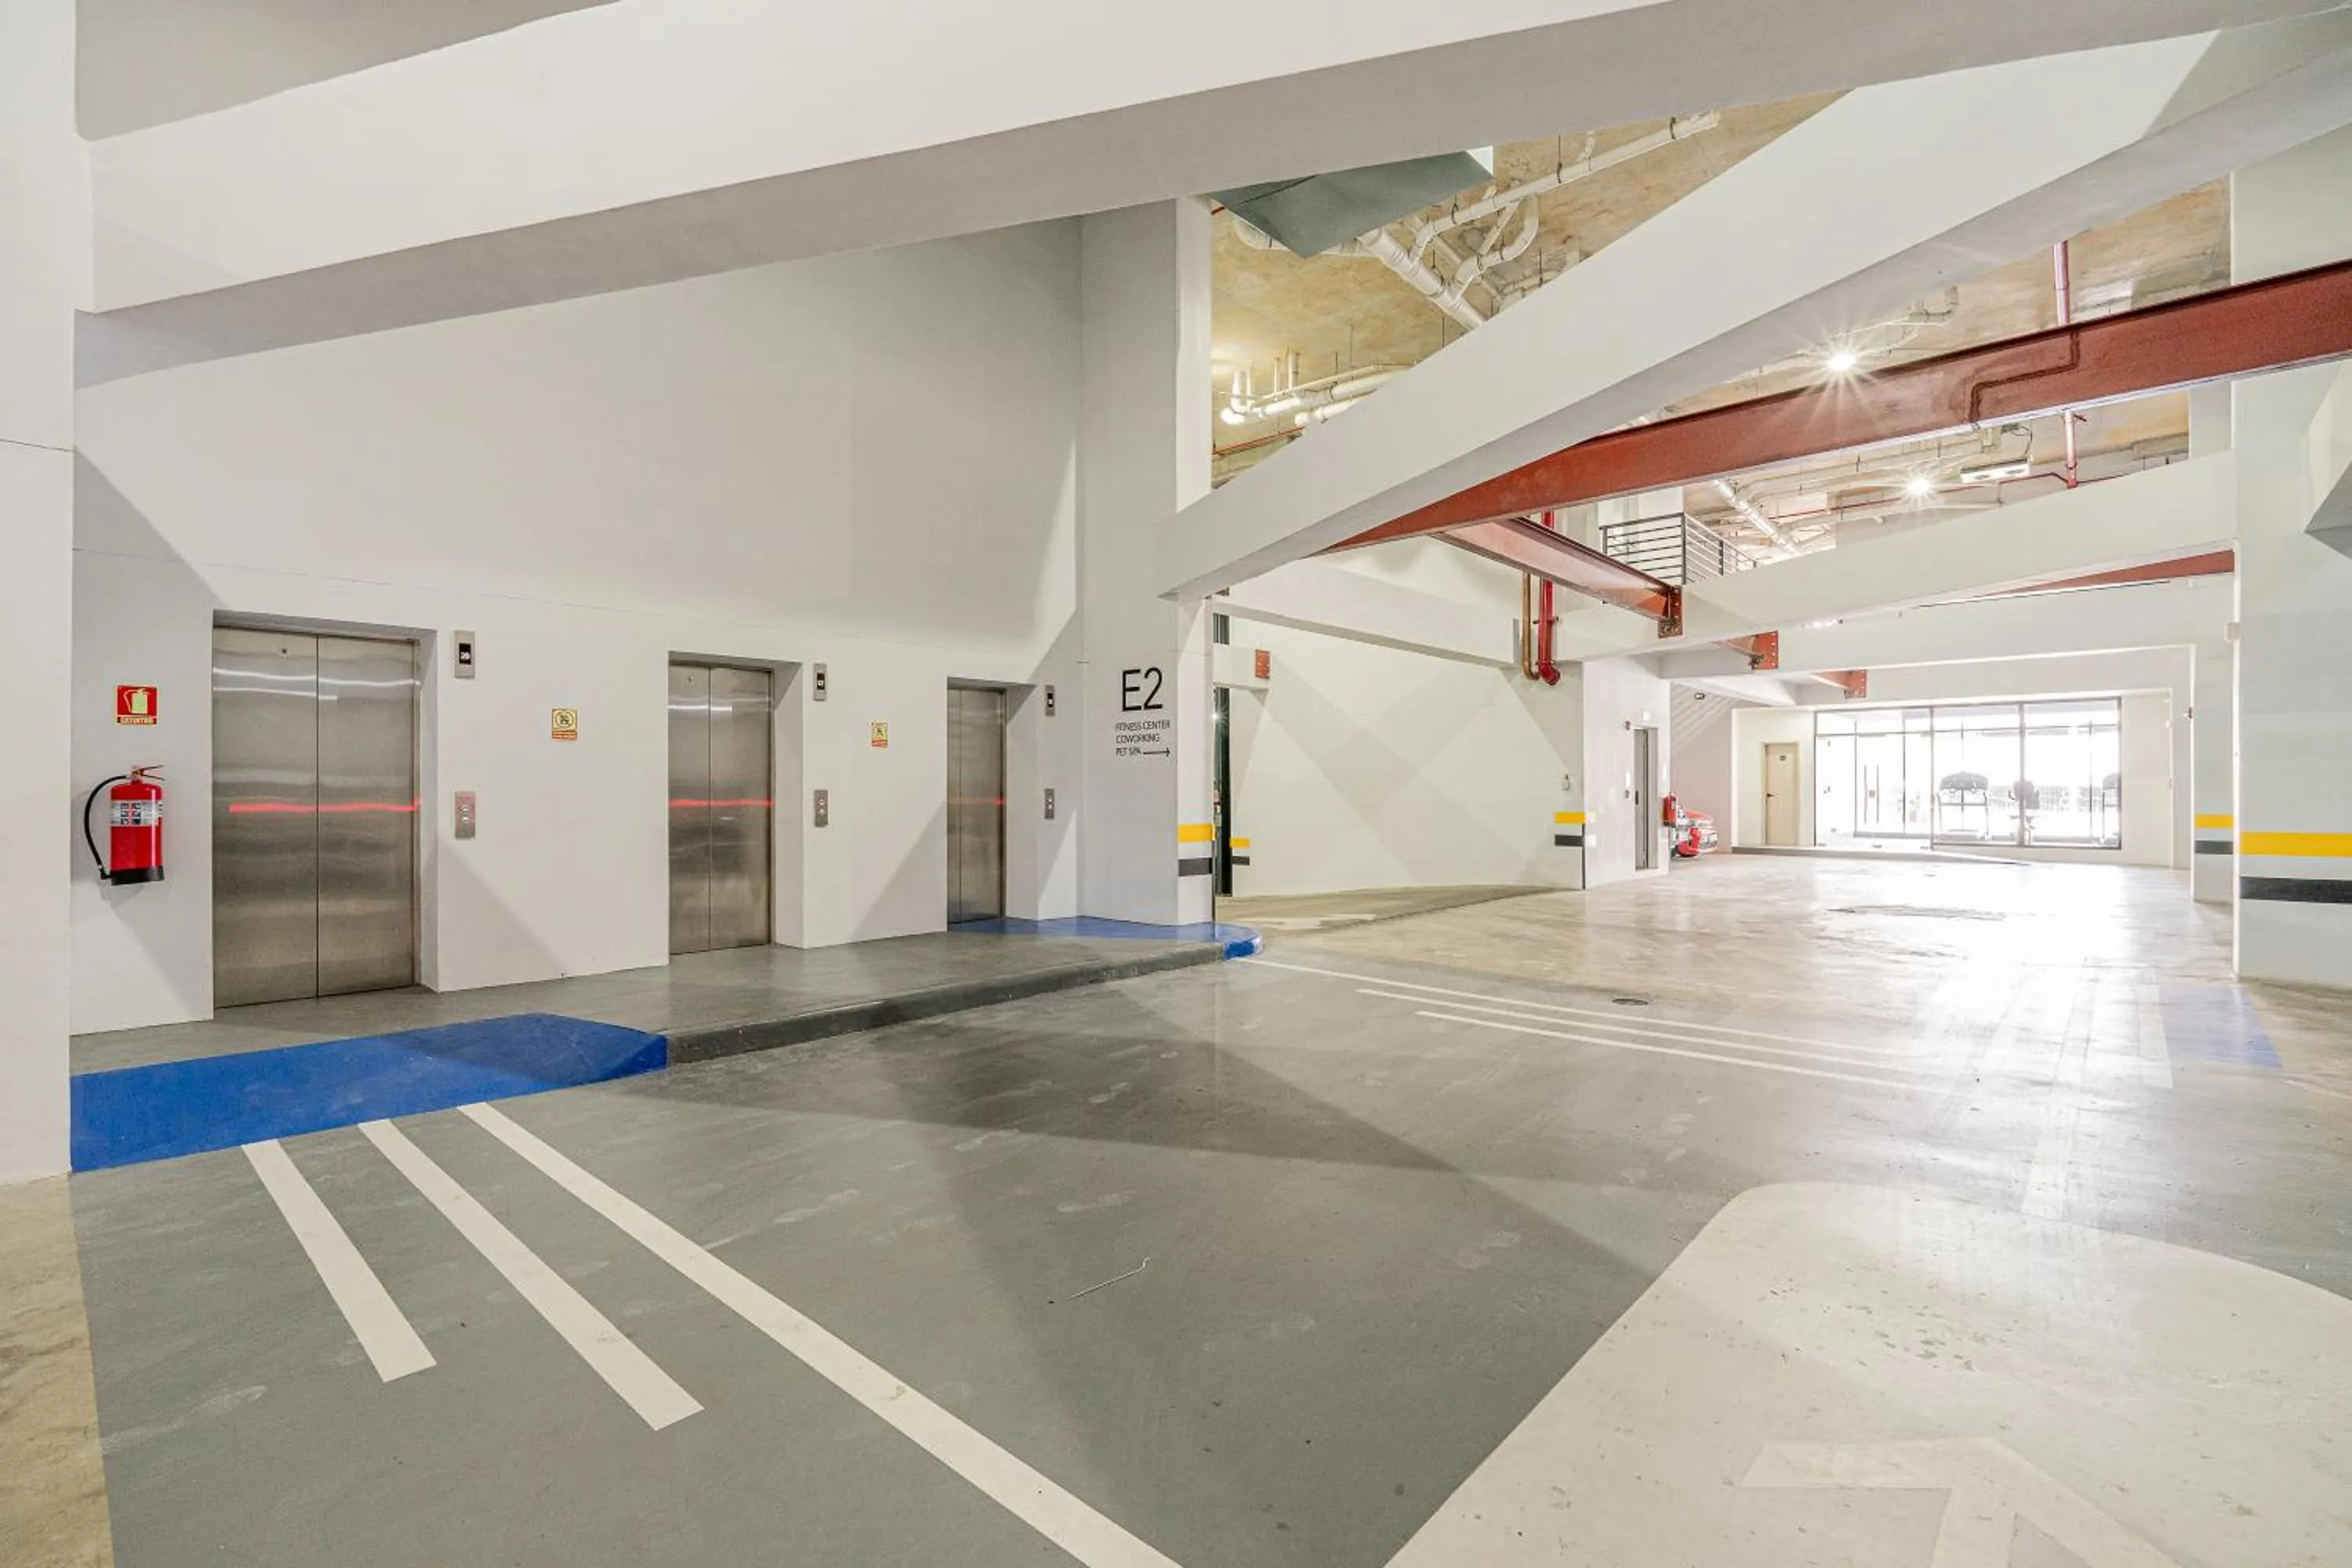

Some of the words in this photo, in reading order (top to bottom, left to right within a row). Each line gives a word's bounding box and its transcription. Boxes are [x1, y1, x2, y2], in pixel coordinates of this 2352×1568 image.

[1122, 666, 1163, 711] E2
[1116, 721, 1142, 731] FITNESS
[1143, 719, 1171, 730] CENTER
[1116, 734, 1160, 744] COWORKING
[1116, 747, 1127, 757] PET
[1128, 746, 1142, 756] SPA
